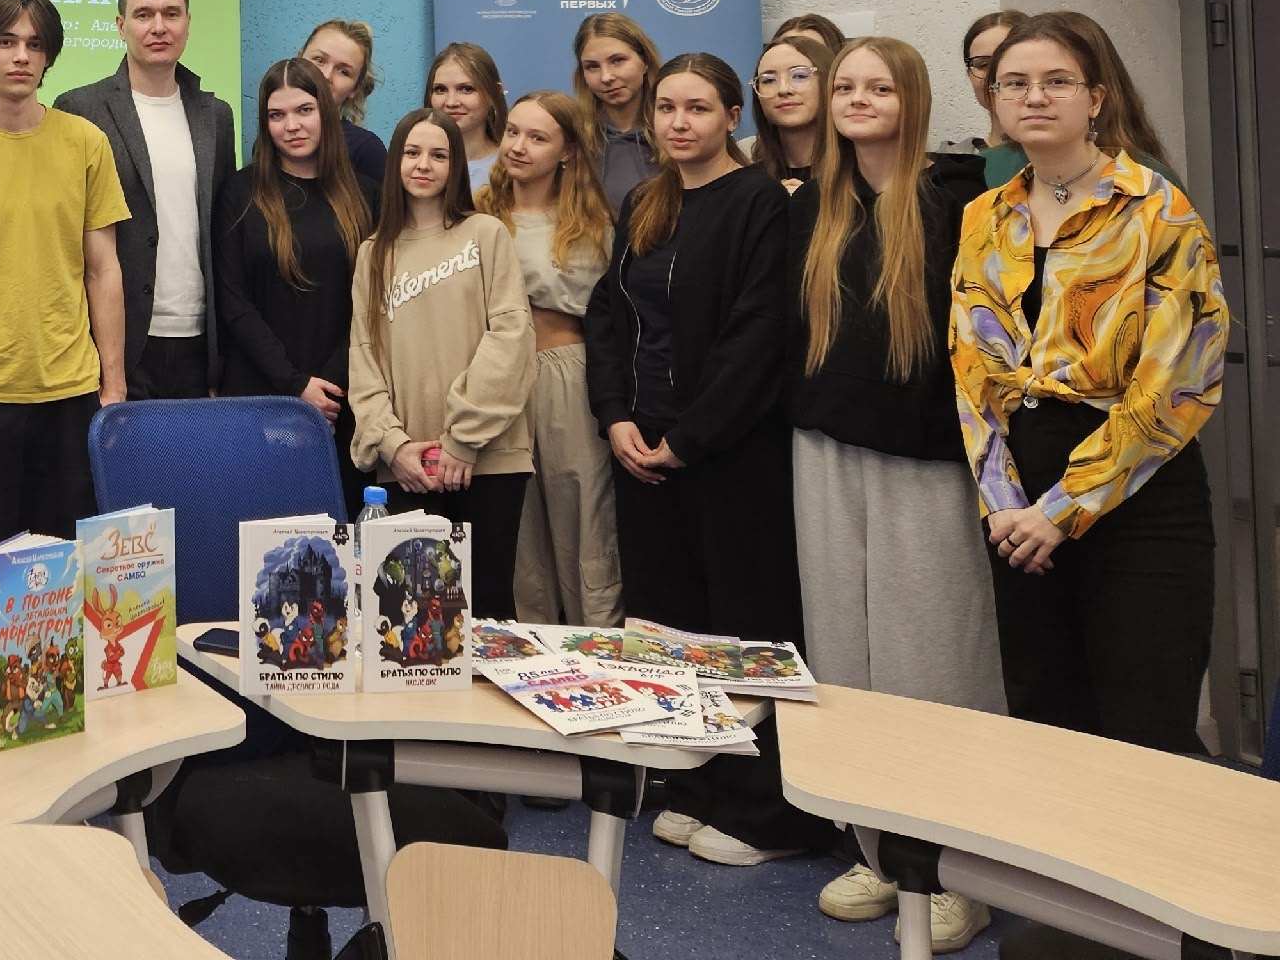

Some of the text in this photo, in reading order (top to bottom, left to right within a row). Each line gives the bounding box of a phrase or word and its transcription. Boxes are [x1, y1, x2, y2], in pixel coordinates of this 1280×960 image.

[560, 0, 617, 9] ПЕРВЫХ
[117, 571, 146, 582] САМБО
[5, 586, 74, 614] В ПОГОНЕ
[259, 672, 344, 681] БРАТЬЯ ПО СТИЛЮ
[380, 667, 461, 678] БРАТЬЯ ПО СТИЛЮ
[527, 674, 589, 686] САМБО
